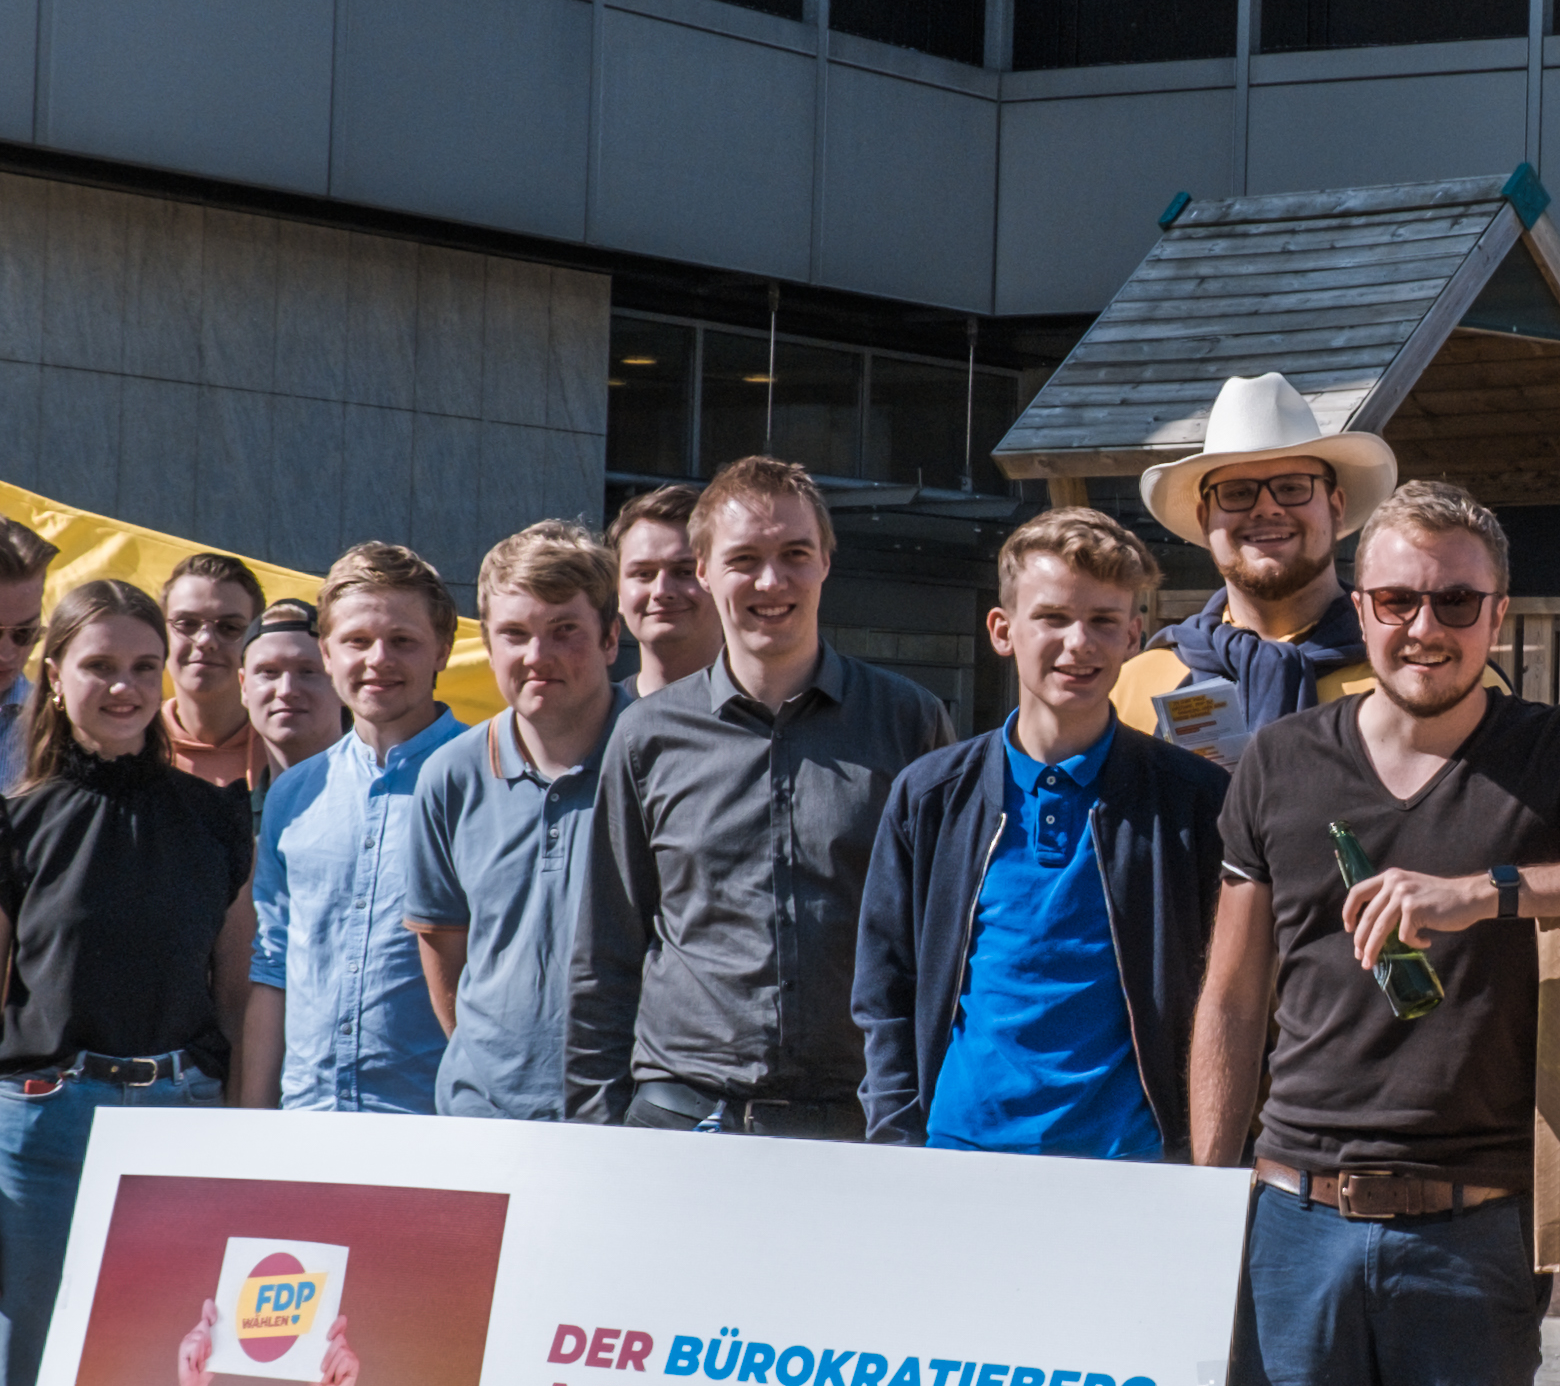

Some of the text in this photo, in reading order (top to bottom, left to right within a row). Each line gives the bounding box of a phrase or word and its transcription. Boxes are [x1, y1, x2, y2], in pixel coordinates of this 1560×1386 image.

[254, 1280, 318, 1316] FDP
[241, 1309, 290, 1332] WÄHLEN
[546, 1322, 655, 1373] DER
